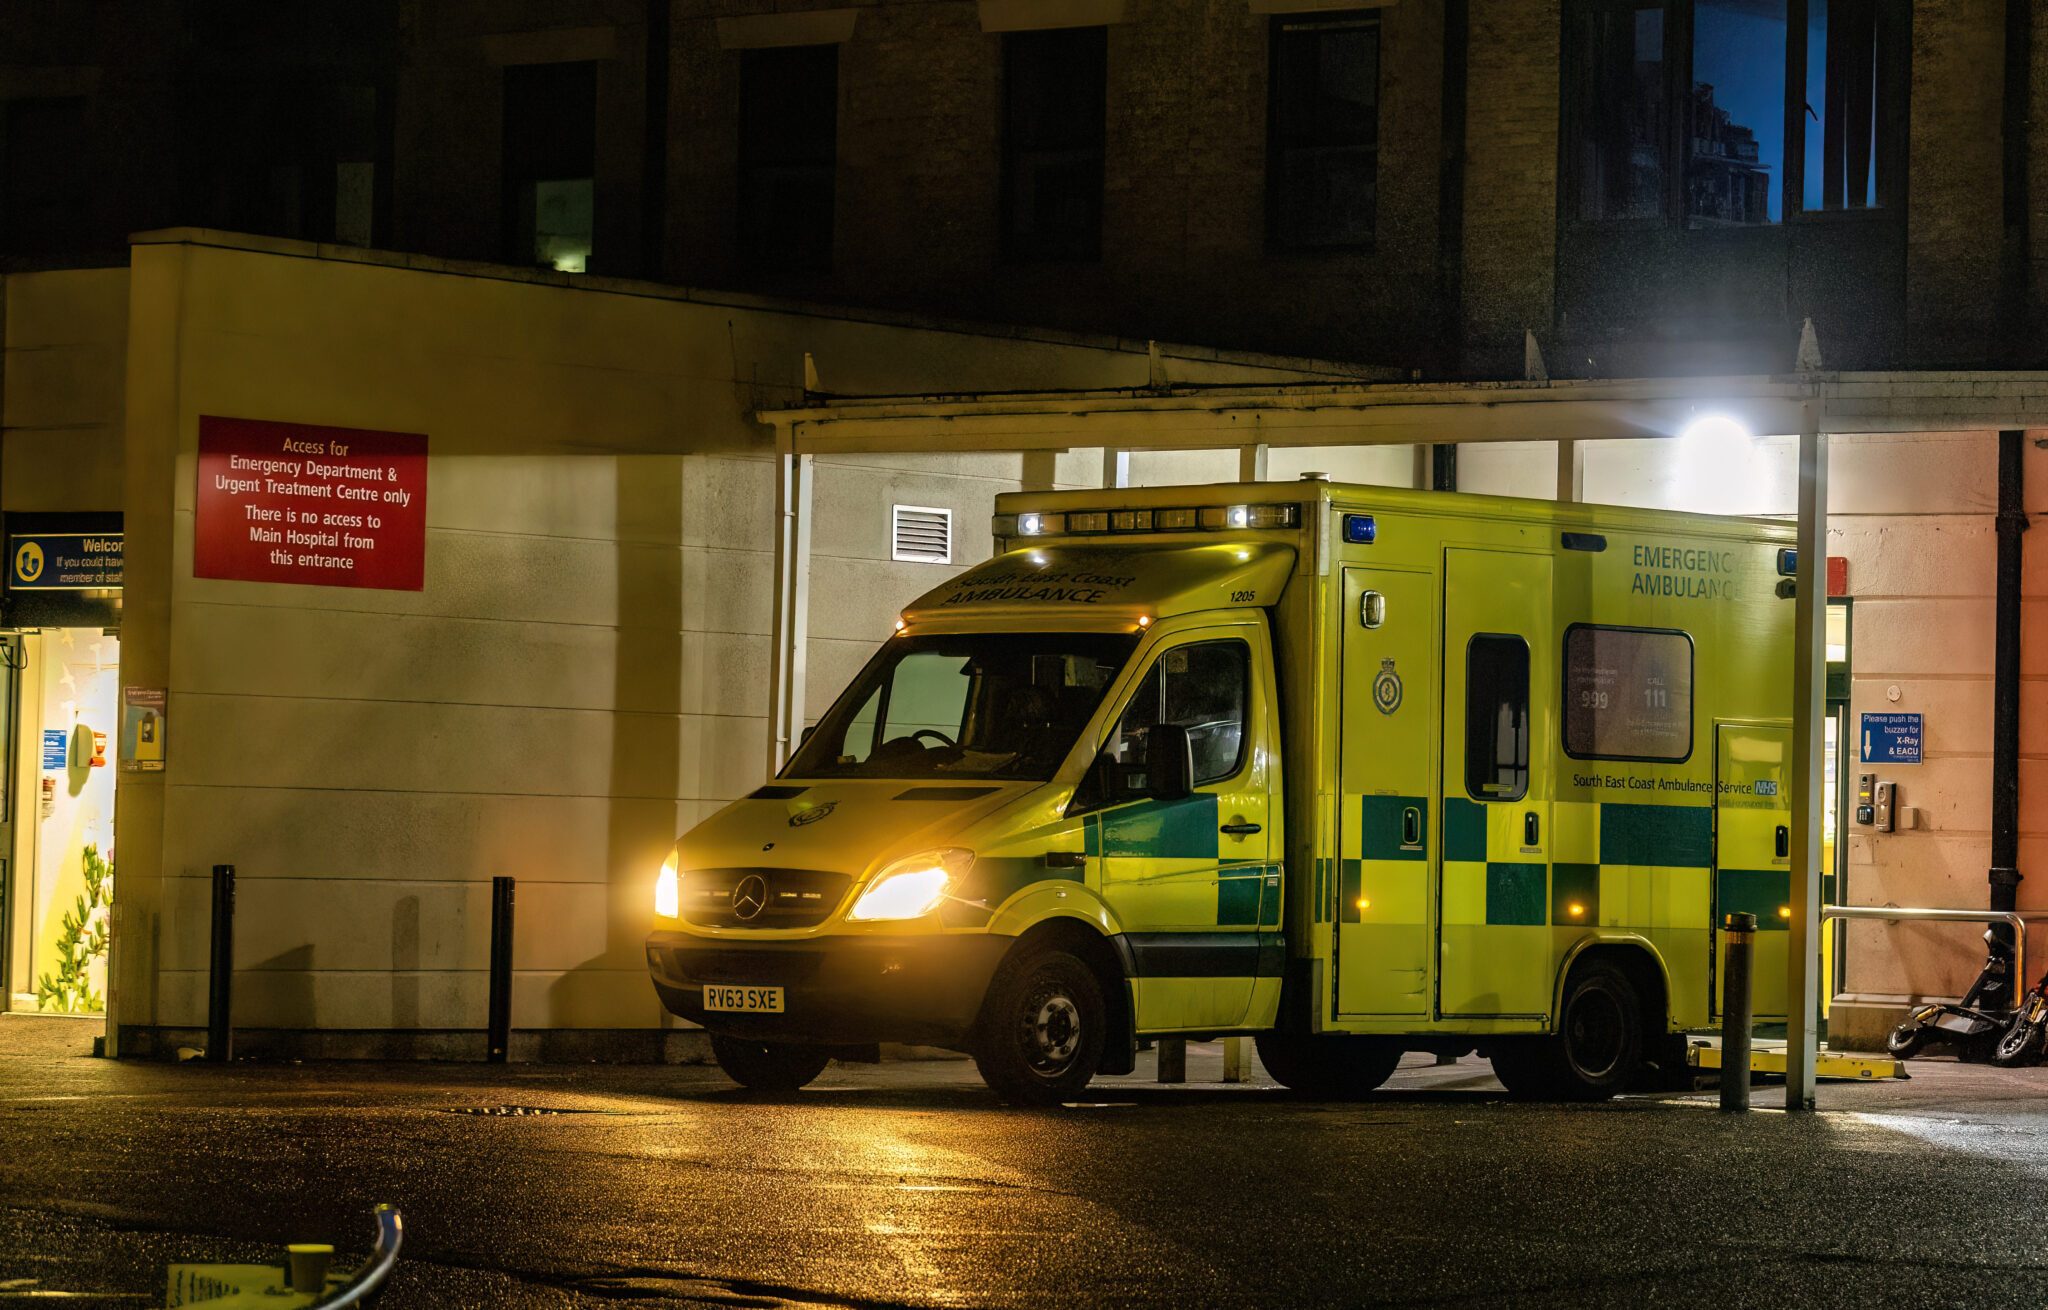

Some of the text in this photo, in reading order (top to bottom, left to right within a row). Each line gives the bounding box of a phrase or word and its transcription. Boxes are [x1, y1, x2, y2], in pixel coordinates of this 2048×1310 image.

[283, 438, 349, 456] Access for
[231, 455, 397, 482] Emergency Department &
[215, 475, 410, 507] Urgent Treatment Centre only
[245, 505, 381, 529] There is no access to
[250, 526, 374, 549] Main Hospital from
[56, 556, 63, 567] If
[64, 557, 79, 569] you
[81, 556, 103, 567] could
[270, 550, 354, 569] this entrance
[60, 571, 93, 582] member
[96, 572, 105, 582] of
[958, 571, 1136, 588] South East Coast
[941, 588, 1106, 605] AMBULANCE
[1230, 590, 1255, 603] 1205
[1581, 690, 1609, 709] 999
[1644, 688, 1666, 707] 111
[1864, 714, 1919, 724] Please push the
[1909, 725, 1919, 733] for
[1897, 736, 1919, 746] X-Ray
[1889, 747, 1919, 755] & EACU
[1573, 774, 1777, 795] South East Coast Ambulance Service NHS
[709, 988, 777, 1009] RV63 SXE
